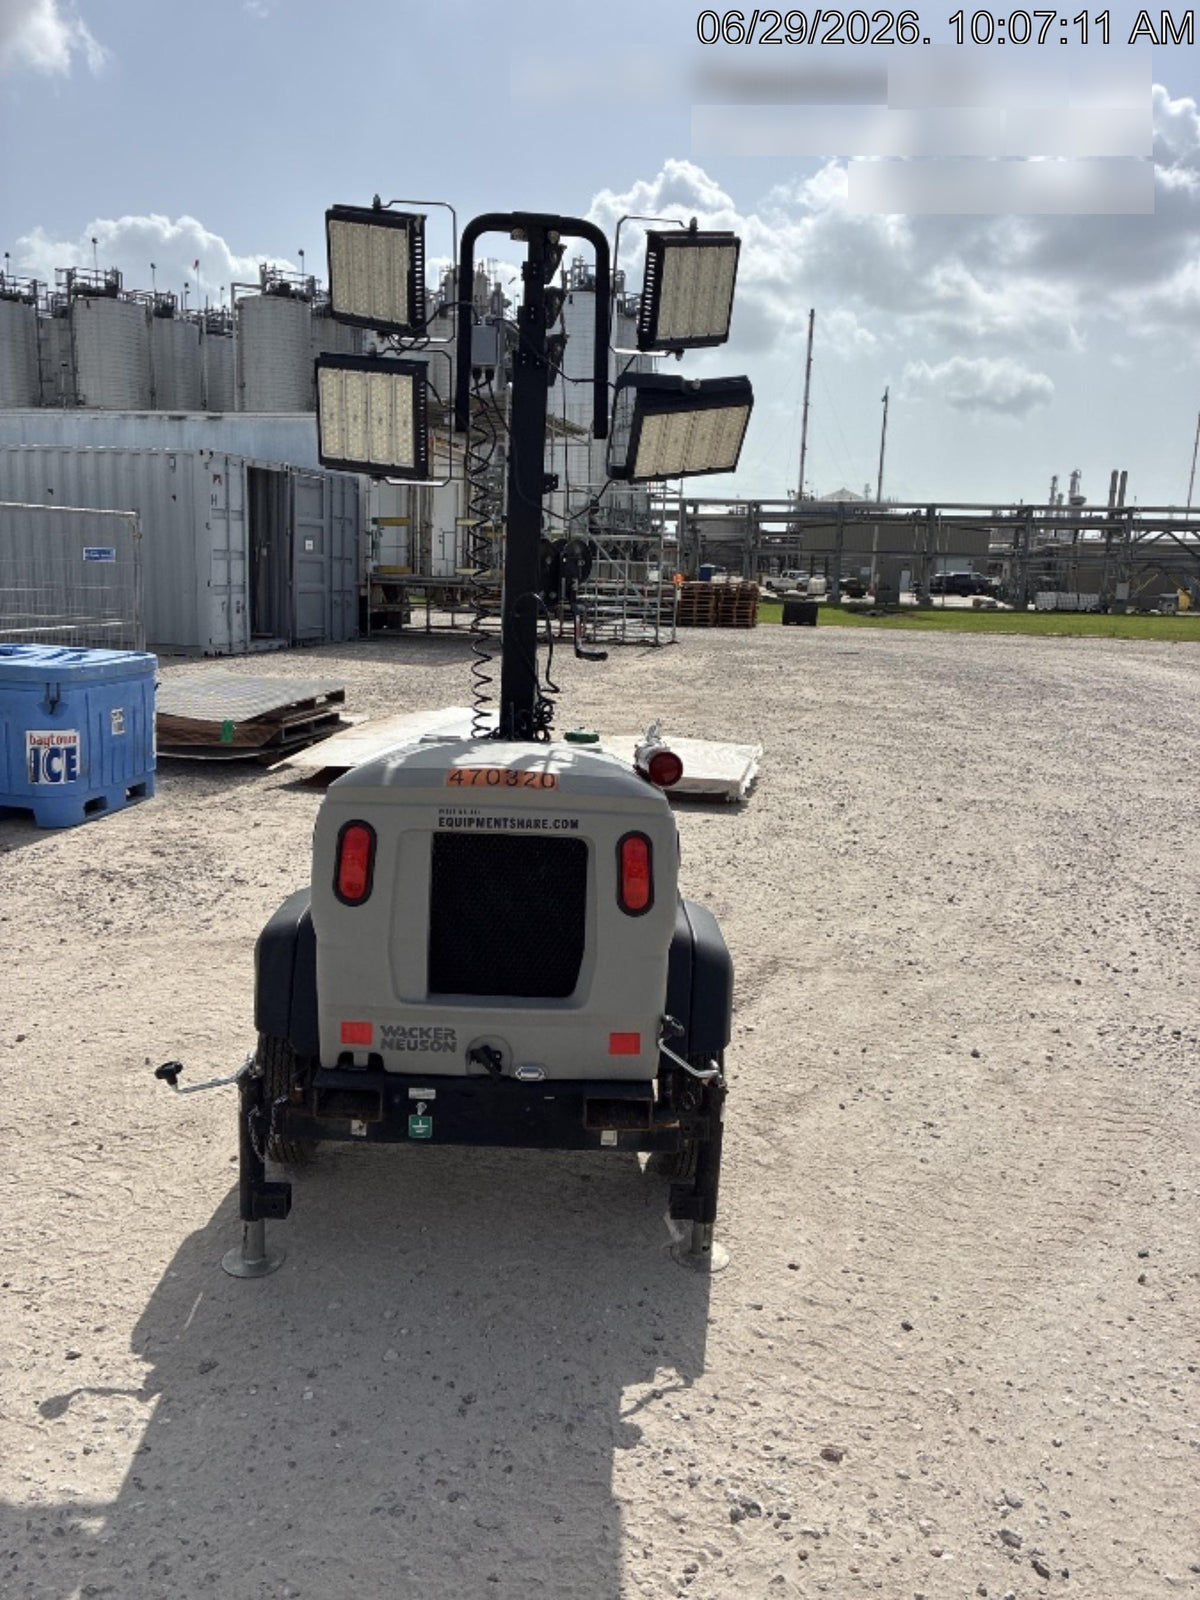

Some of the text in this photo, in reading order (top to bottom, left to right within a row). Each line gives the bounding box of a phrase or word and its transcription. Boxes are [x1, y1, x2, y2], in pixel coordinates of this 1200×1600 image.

[29, 747, 77, 782] ICE
[449, 769, 556, 788] 470320
[438, 817, 579, 829] EQUIPMENTSHARE.COM
[380, 1025, 457, 1040] WACKER
[380, 1038, 457, 1053] NEUSON
